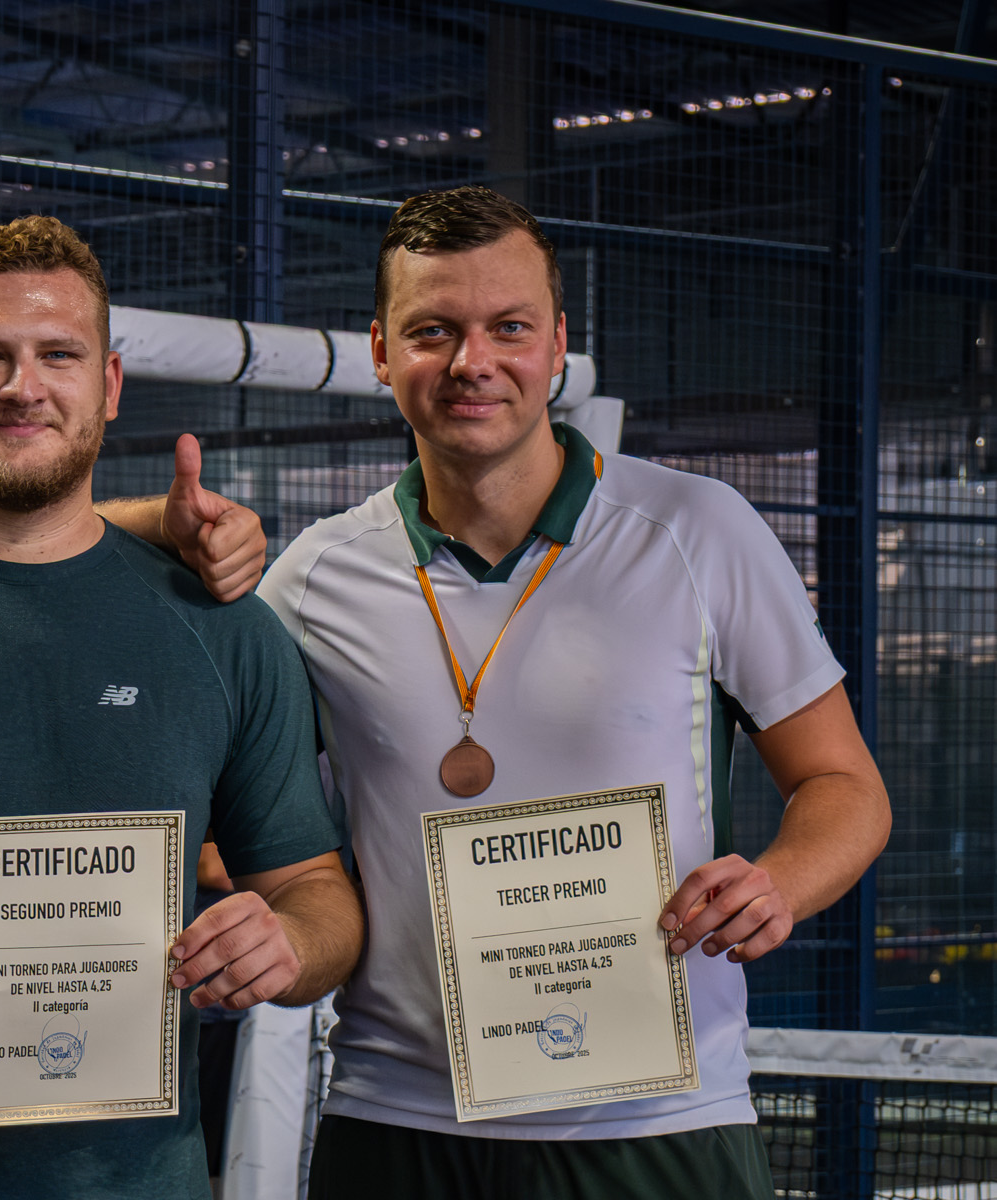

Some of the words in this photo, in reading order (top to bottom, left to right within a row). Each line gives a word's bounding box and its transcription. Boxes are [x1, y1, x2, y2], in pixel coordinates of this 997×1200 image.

[471, 821, 622, 866] CERTIFICADO
[496, 884, 550, 907] TERCER
[553, 877, 607, 900] PREMIO
[0, 902, 65, 920] SEGUNDO
[69, 900, 122, 919] PREMIO
[480, 949, 504, 964] MINI
[506, 944, 546, 961] TORNEO
[548, 940, 576, 956] PARA
[577, 932, 637, 952] JUGADORES
[10, 962, 49, 977] TORNEO
[51, 961, 77, 975] PARA
[79, 959, 138, 974] JUGADORES
[508, 965, 523, 980] DE
[525, 962, 555, 978] NIVEL
[557, 958, 589, 974] HASTA
[10, 982, 24, 996] DE
[26, 981, 55, 995] NIVEL
[57, 980, 88, 994] HASTA
[534, 982, 542, 995] II
[544, 976, 592, 996] categoría
[33, 1000, 40, 1013] II
[42, 998, 89, 1015] categoría
[481, 1023, 513, 1040] LINDO
[514, 1019, 548, 1036] PADEL
[8, 1045, 39, 1059] PADEL
